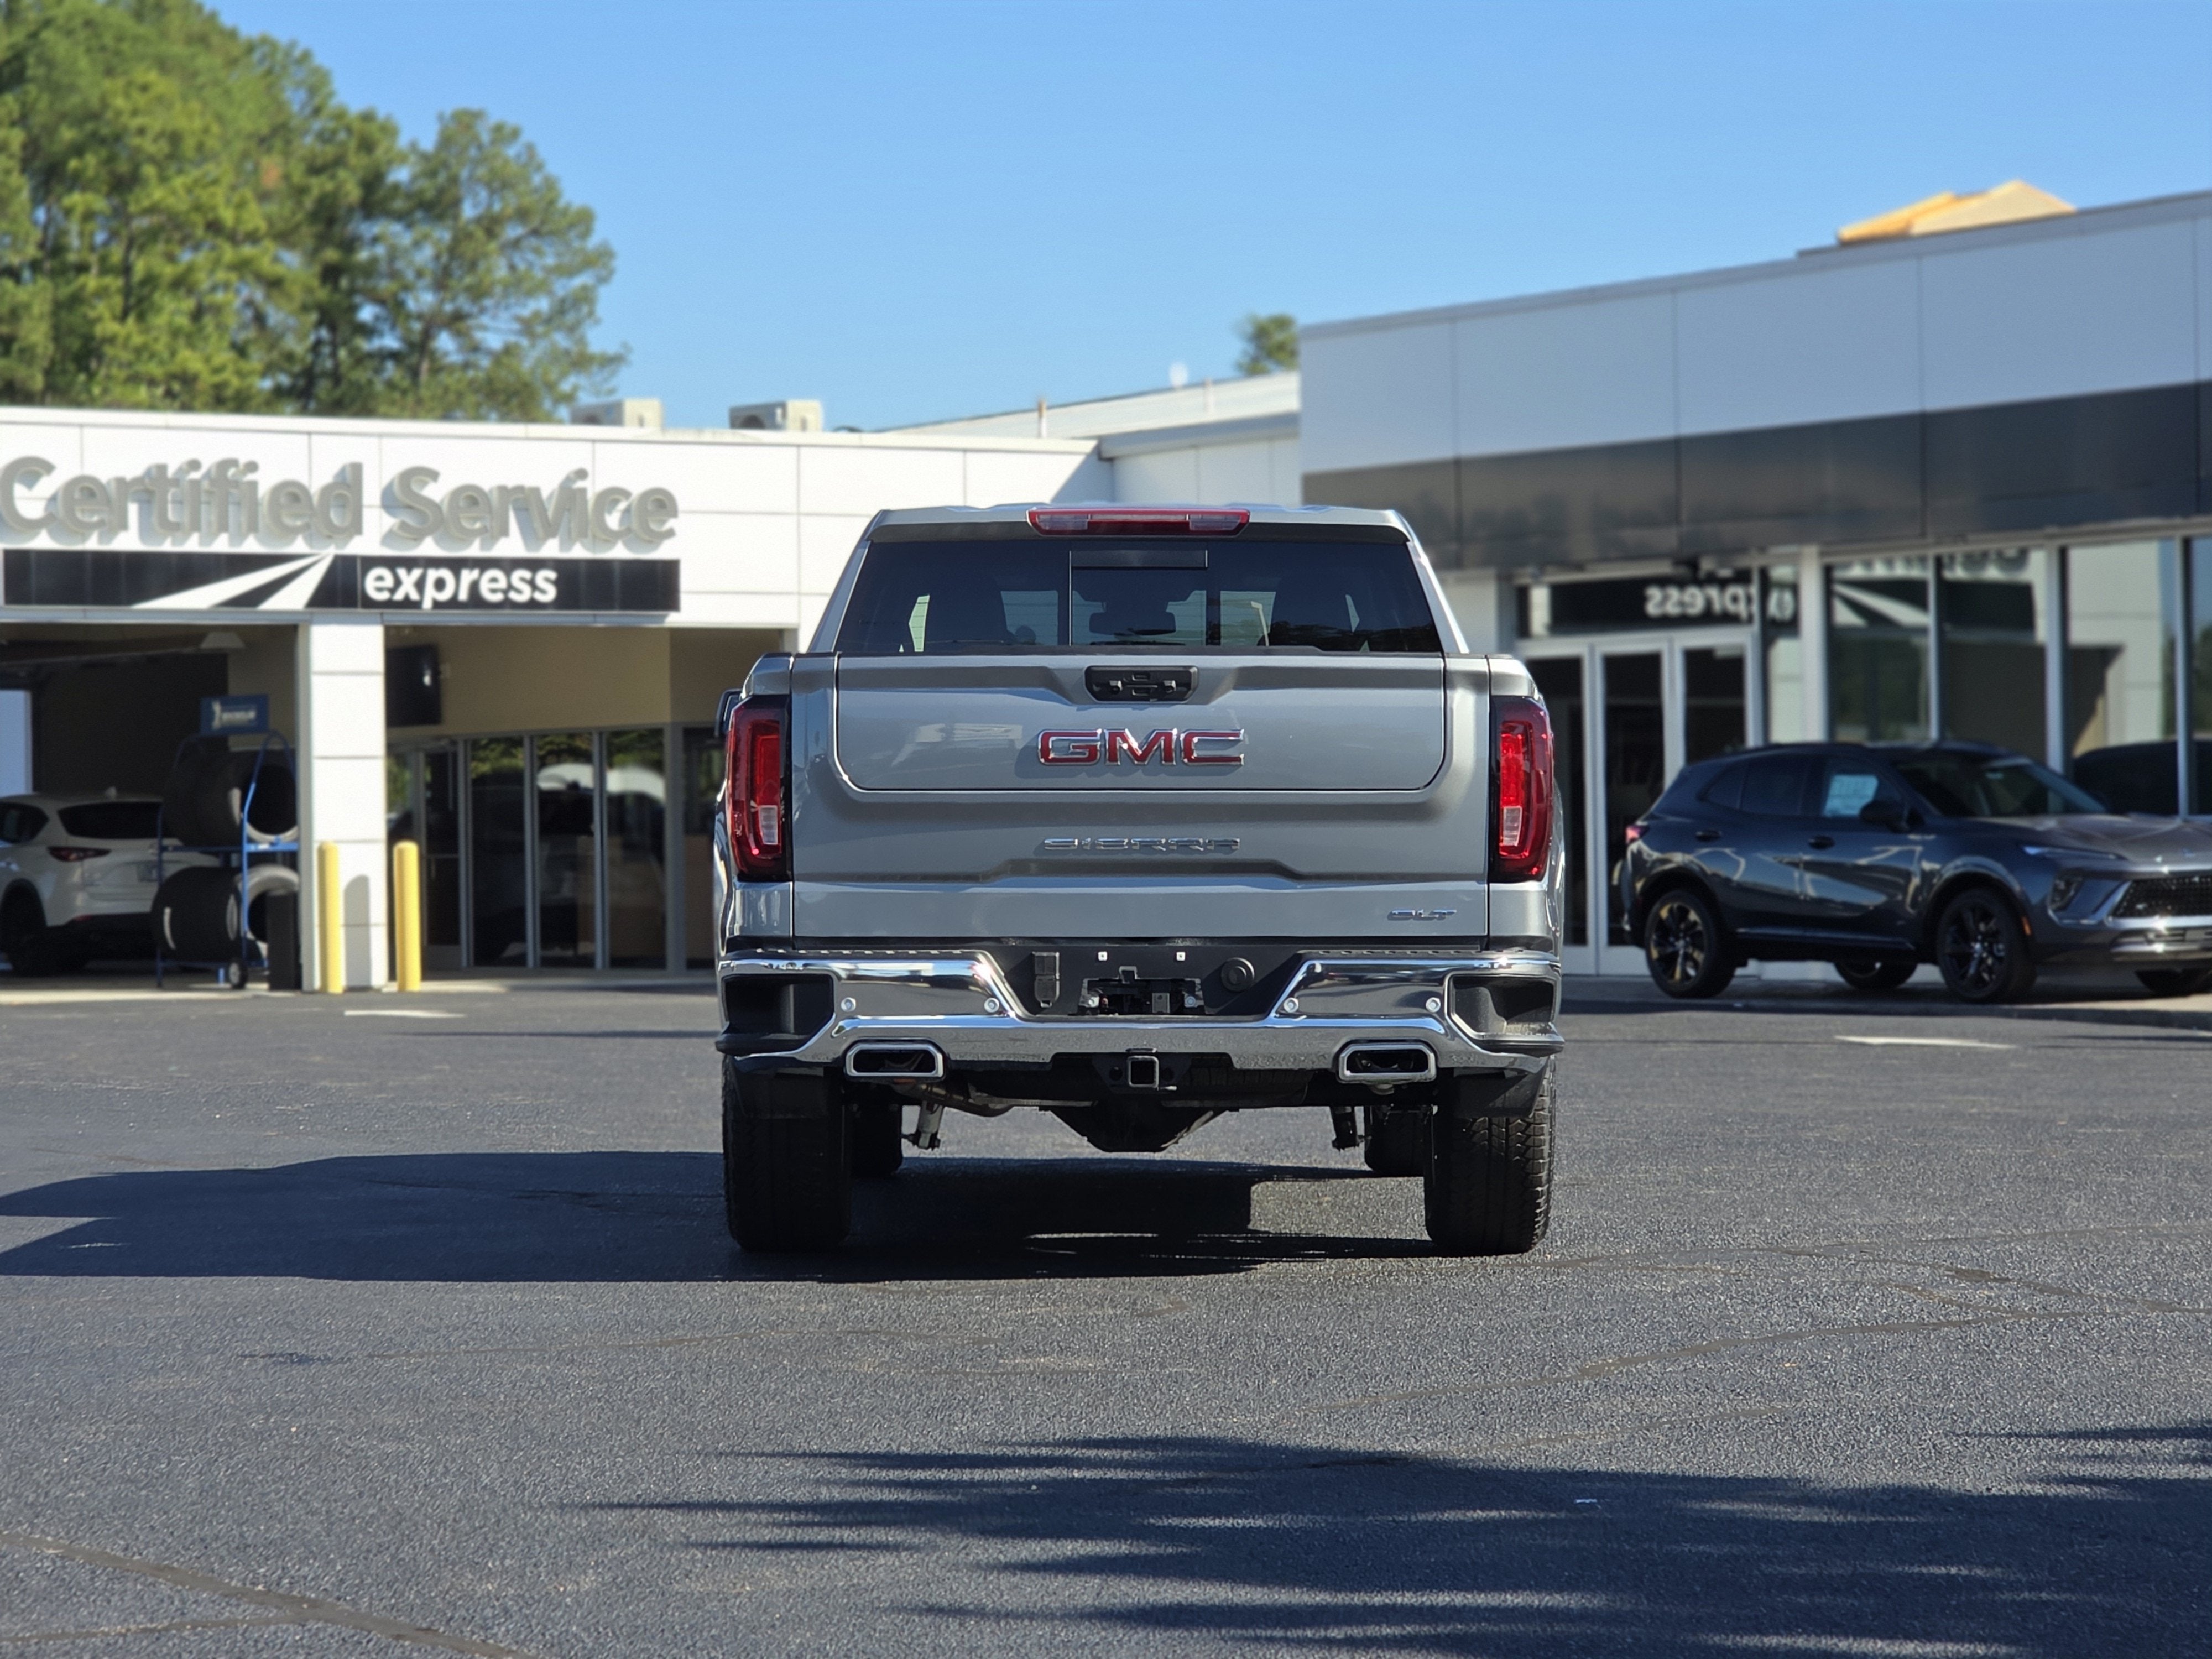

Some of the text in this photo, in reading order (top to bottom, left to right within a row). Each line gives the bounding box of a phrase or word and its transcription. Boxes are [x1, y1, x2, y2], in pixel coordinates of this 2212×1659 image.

[0, 456, 679, 544] Certified Service
[363, 565, 559, 609] express
[1037, 728, 1245, 766] GMC
[1044, 837, 1241, 851] SIERRA
[1390, 909, 1457, 919] SLT
